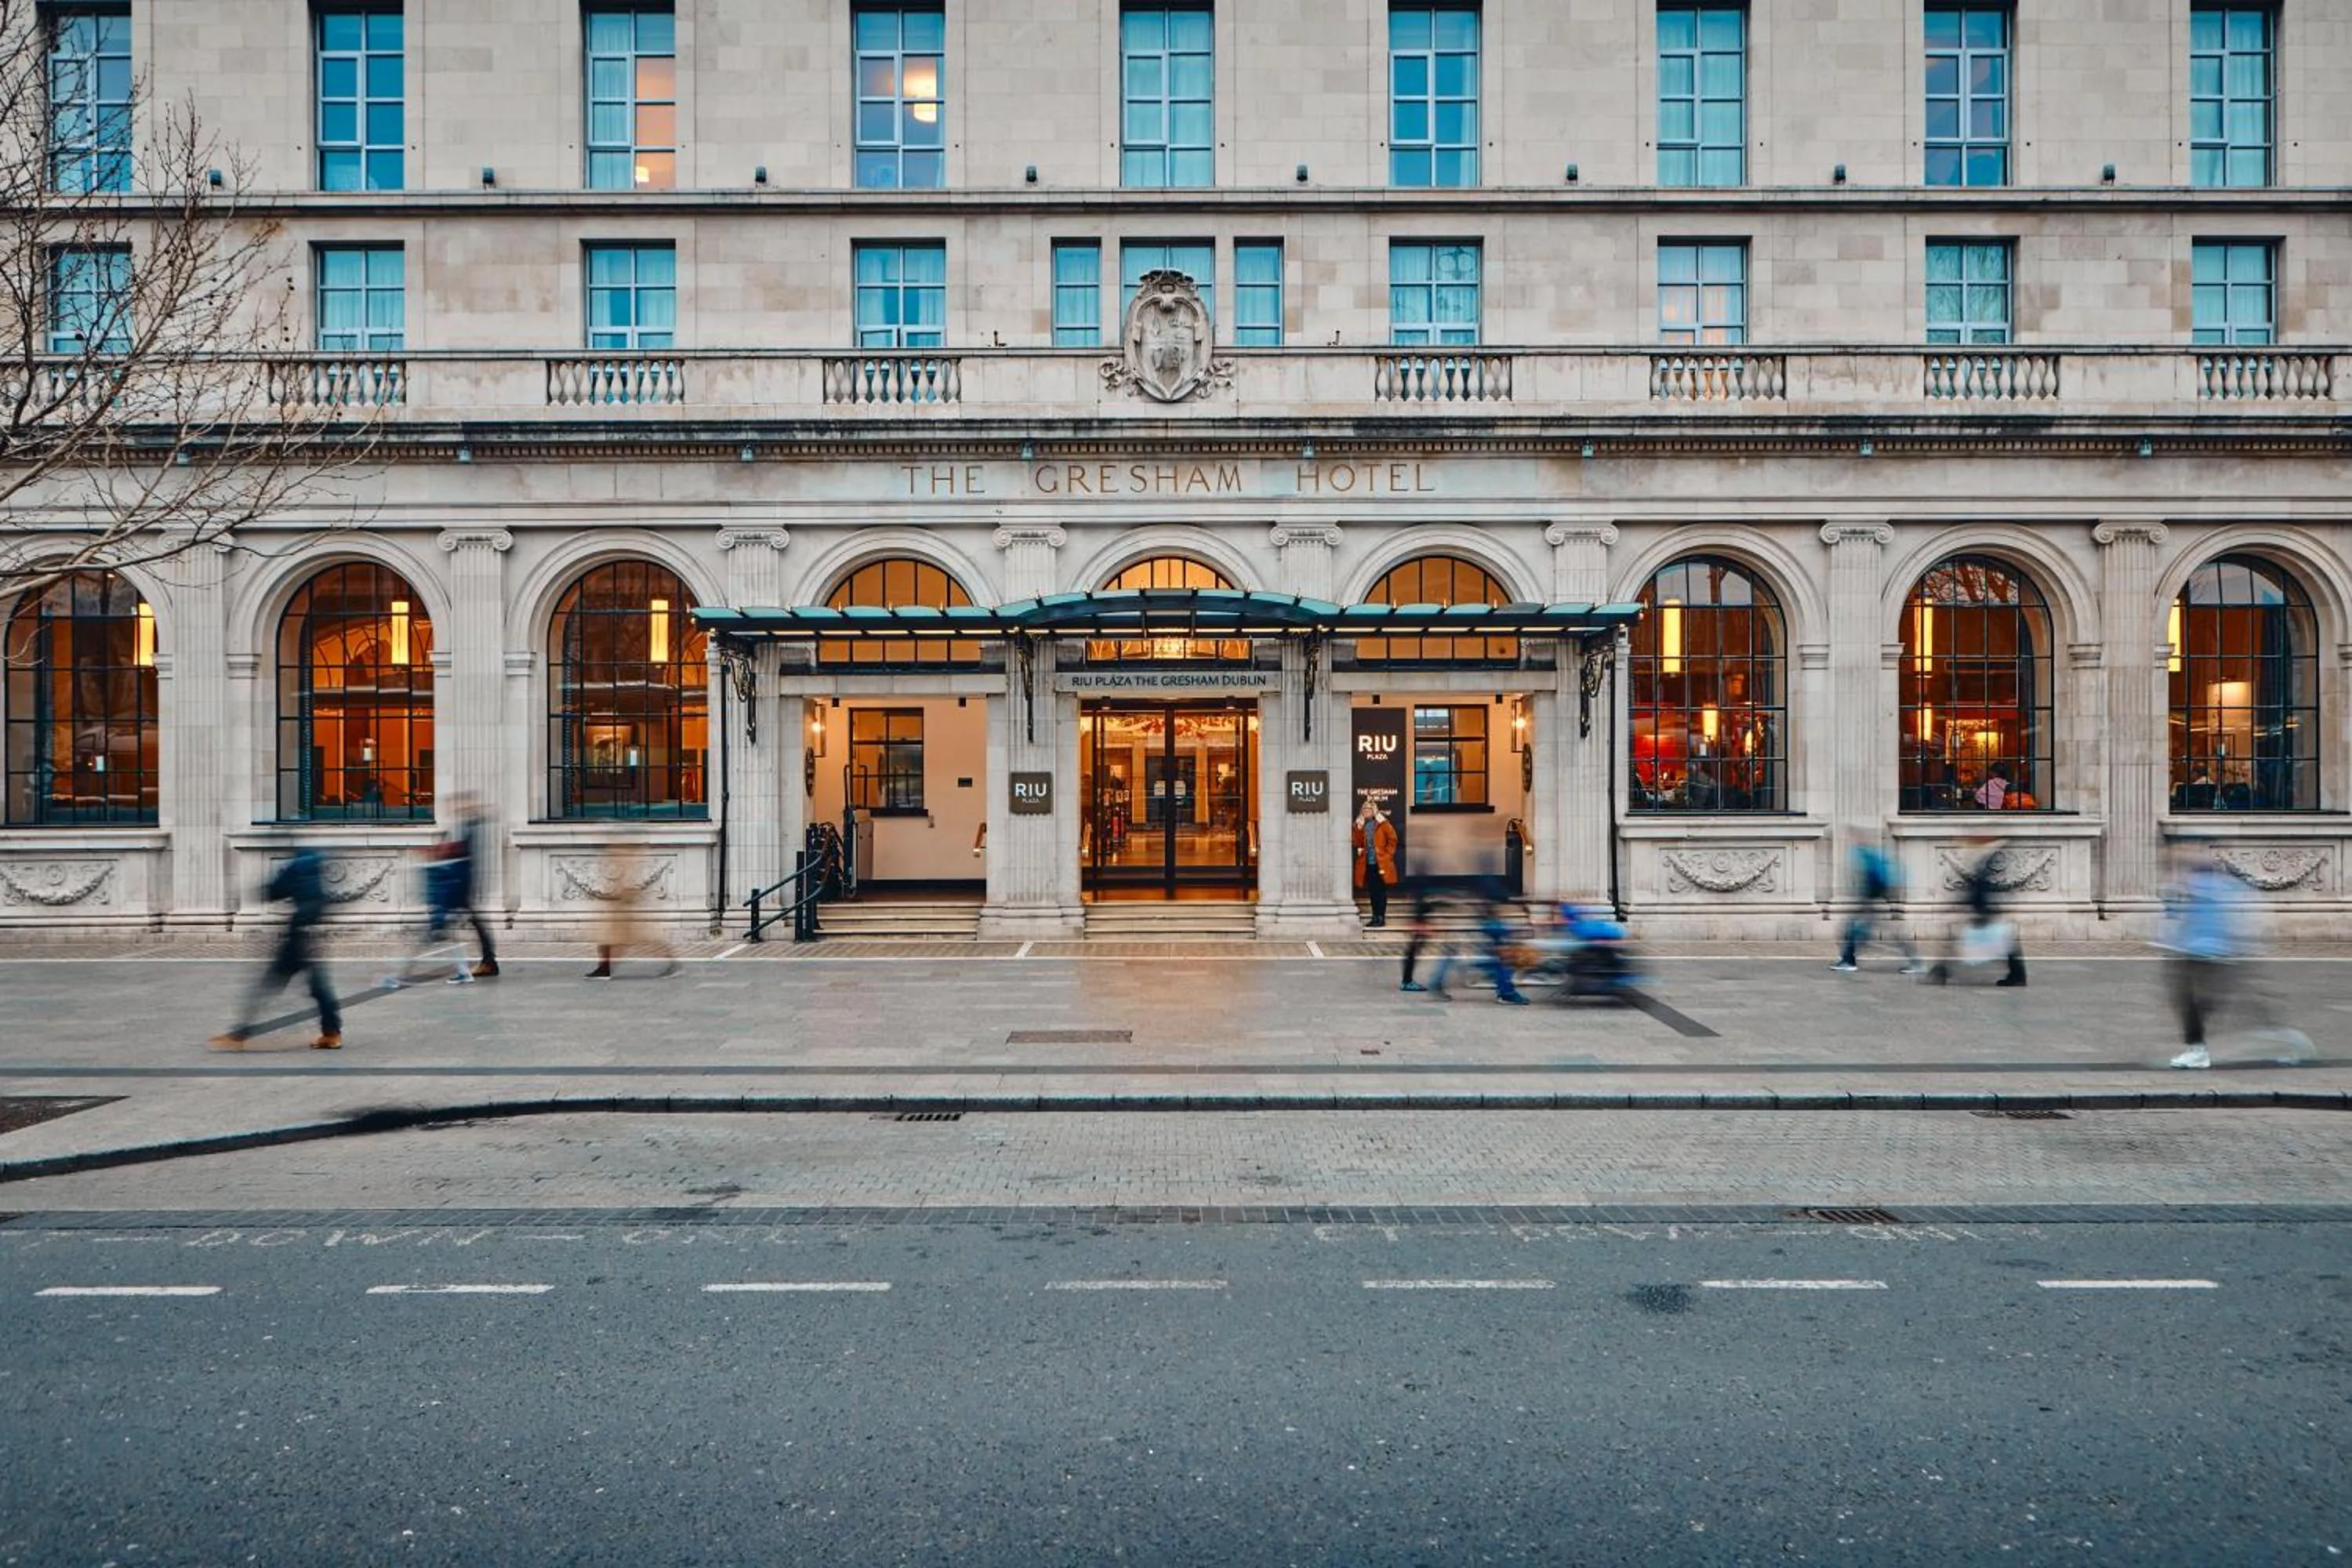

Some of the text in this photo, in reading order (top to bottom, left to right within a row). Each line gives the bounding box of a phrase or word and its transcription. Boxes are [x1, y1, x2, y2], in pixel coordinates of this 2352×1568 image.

[902, 463, 1436, 494] THE GRESHAM HOTEL
[1072, 675, 1267, 686] RIU PLAZA THE GRESHAM DUBLIN
[1359, 735, 1396, 753] RIU
[1015, 782, 1047, 797] RIU
[1291, 781, 1323, 796] RIU
